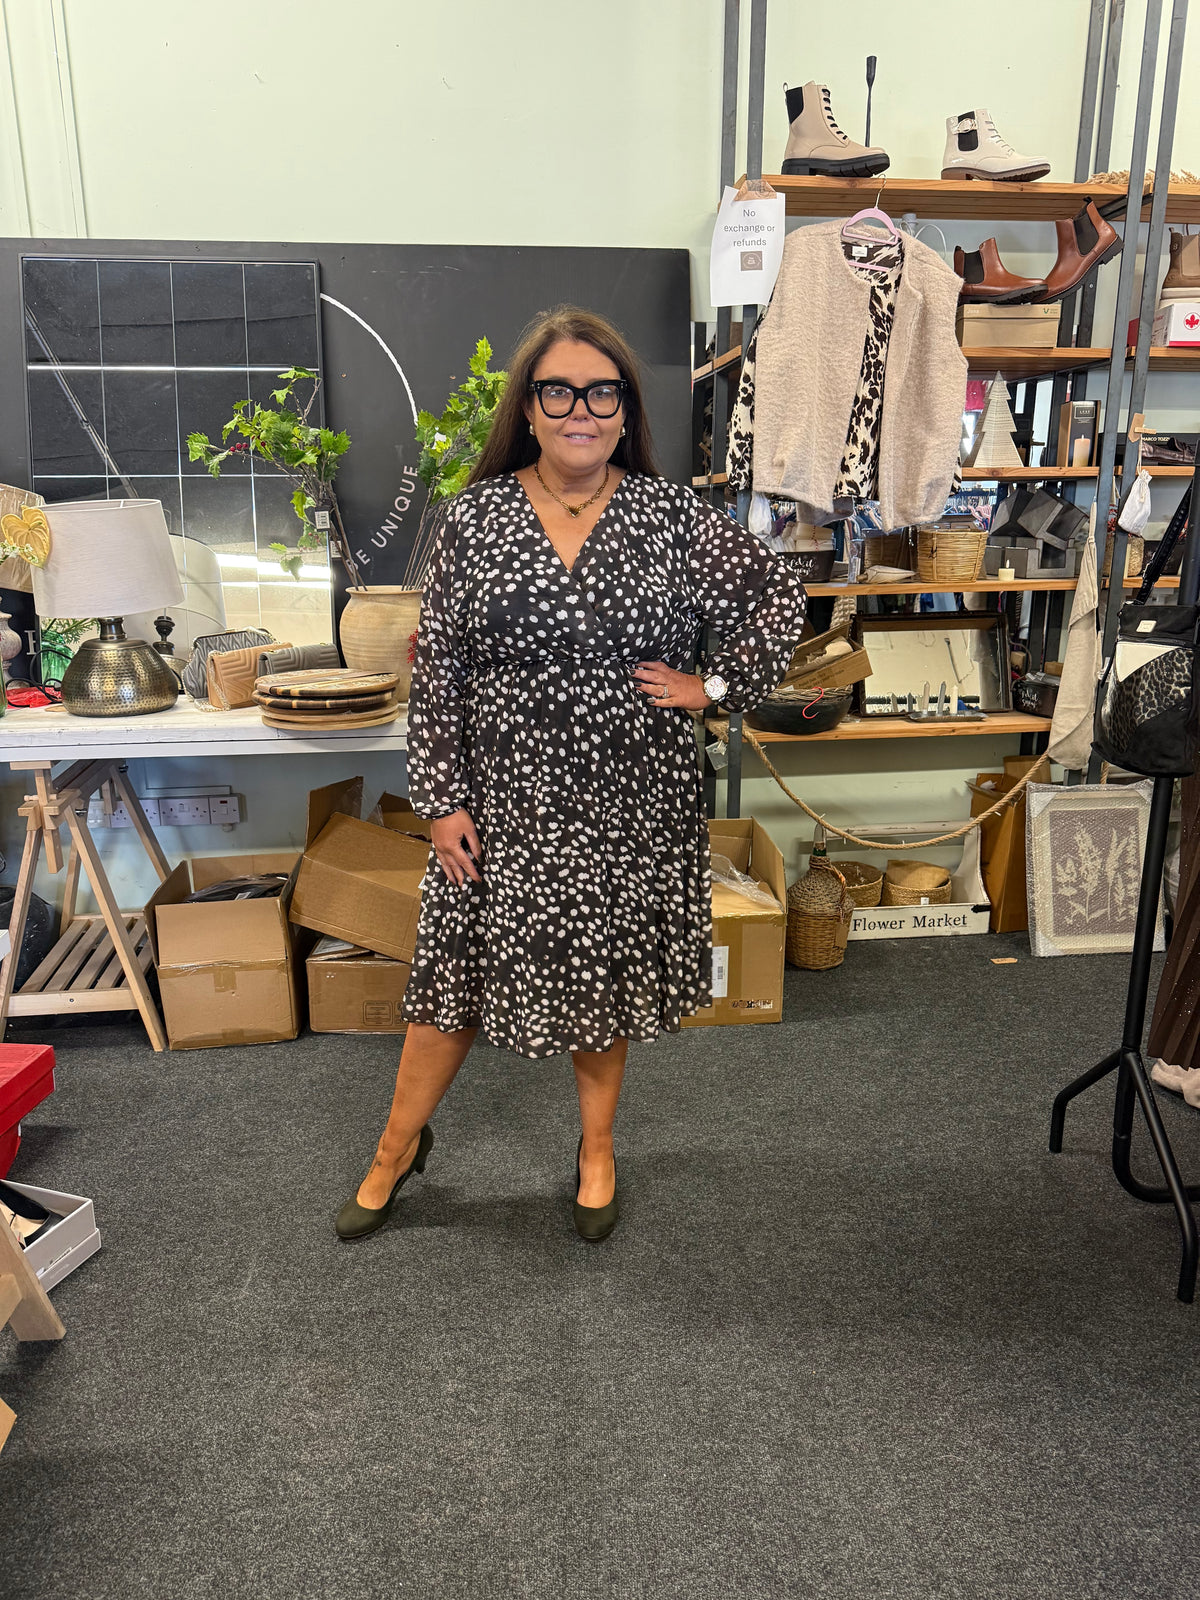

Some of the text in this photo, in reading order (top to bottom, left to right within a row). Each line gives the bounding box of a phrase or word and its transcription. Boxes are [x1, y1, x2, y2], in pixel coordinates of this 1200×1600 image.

[743, 209, 756, 217] No
[723, 224, 765, 233] exchange
[733, 238, 767, 247] refunds
[346, 465, 418, 574] BE UNIQUE
[852, 913, 968, 932] Flower Market
